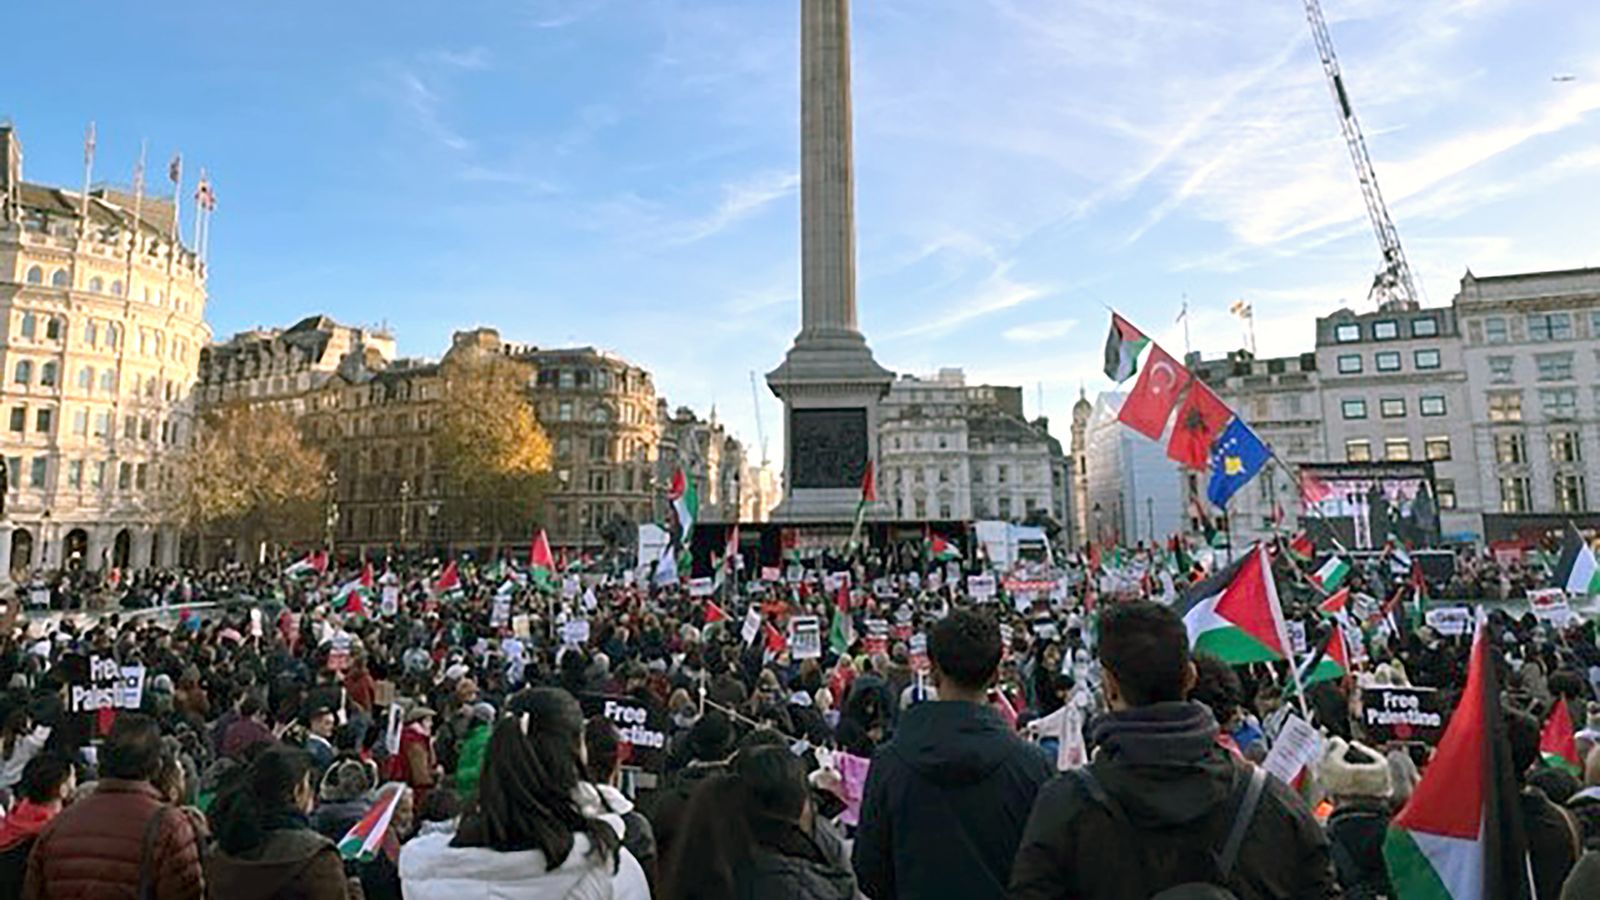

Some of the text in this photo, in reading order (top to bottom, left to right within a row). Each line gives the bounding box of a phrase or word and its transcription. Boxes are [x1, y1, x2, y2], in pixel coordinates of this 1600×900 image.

[1382, 691, 1419, 708] Free
[604, 701, 647, 724] Free
[1367, 708, 1441, 727] Palestine
